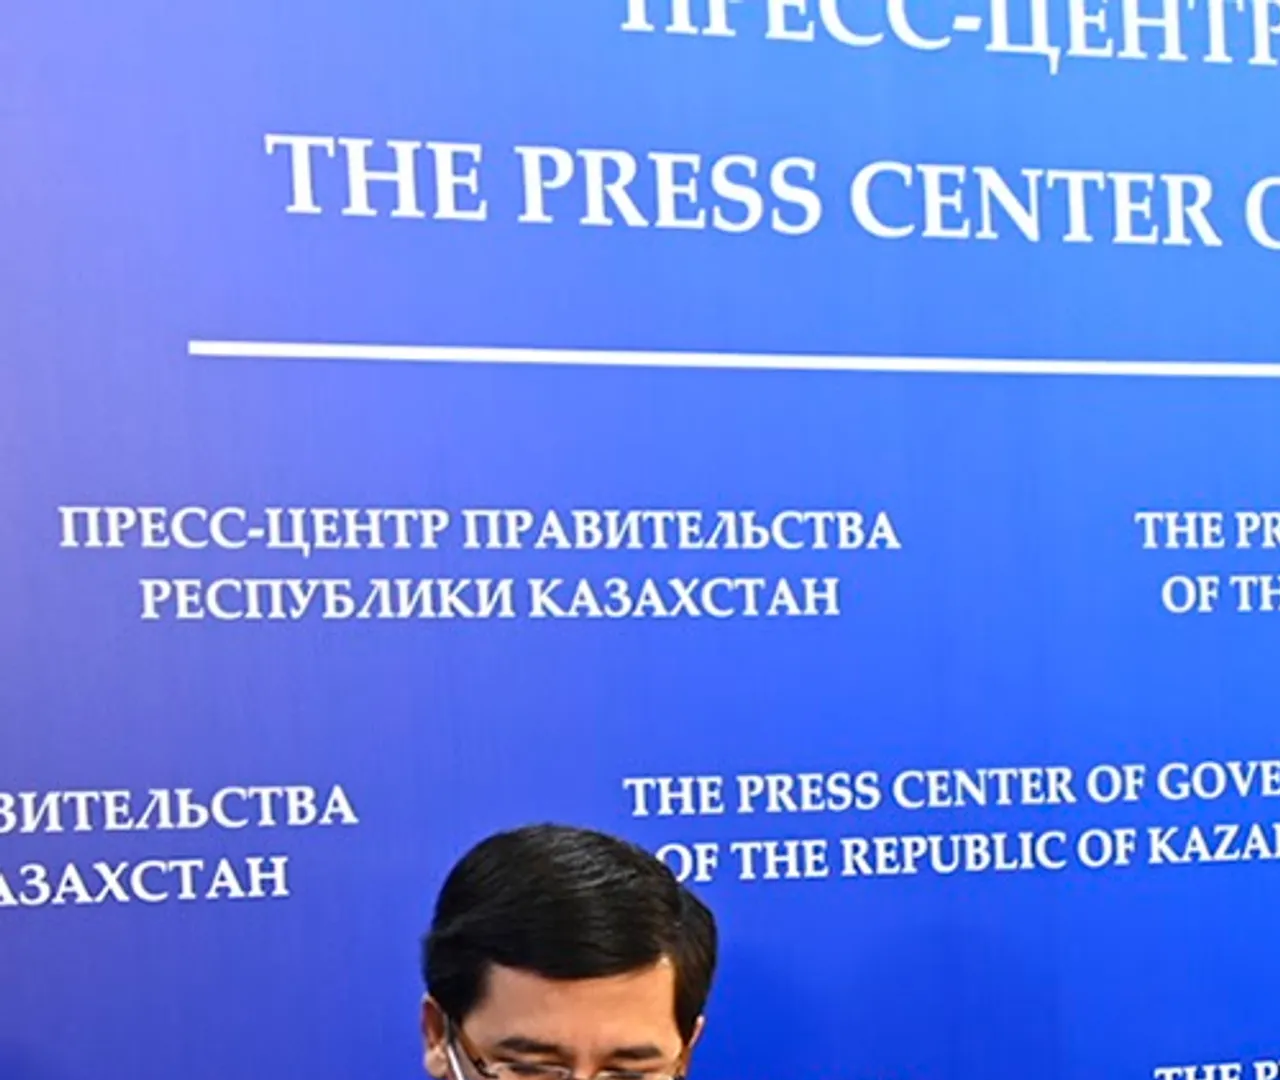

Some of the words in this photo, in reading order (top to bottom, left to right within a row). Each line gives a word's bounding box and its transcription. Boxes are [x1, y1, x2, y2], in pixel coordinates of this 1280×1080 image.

[265, 135, 486, 220] THE
[515, 147, 821, 234] PRESS
[851, 162, 1222, 246] CENTER
[59, 507, 449, 557] ПРЕСС-ЦЕНТР
[462, 510, 901, 549] ПРАВИТЕЛЬСТВА
[1135, 512, 1224, 548] THE
[141, 579, 515, 619] РЕСПУБЛИКИ
[528, 578, 839, 617] КАЗАХСТАН
[1162, 576, 1219, 613] OF
[623, 776, 724, 816] THE
[737, 771, 882, 813] PRESS
[893, 767, 1077, 809] CENTER
[1087, 764, 1145, 803] OF
[655, 841, 720, 883] OF
[730, 839, 829, 879] THE
[840, 830, 1067, 876] REPUBLIC
[1077, 828, 1136, 868] OF
